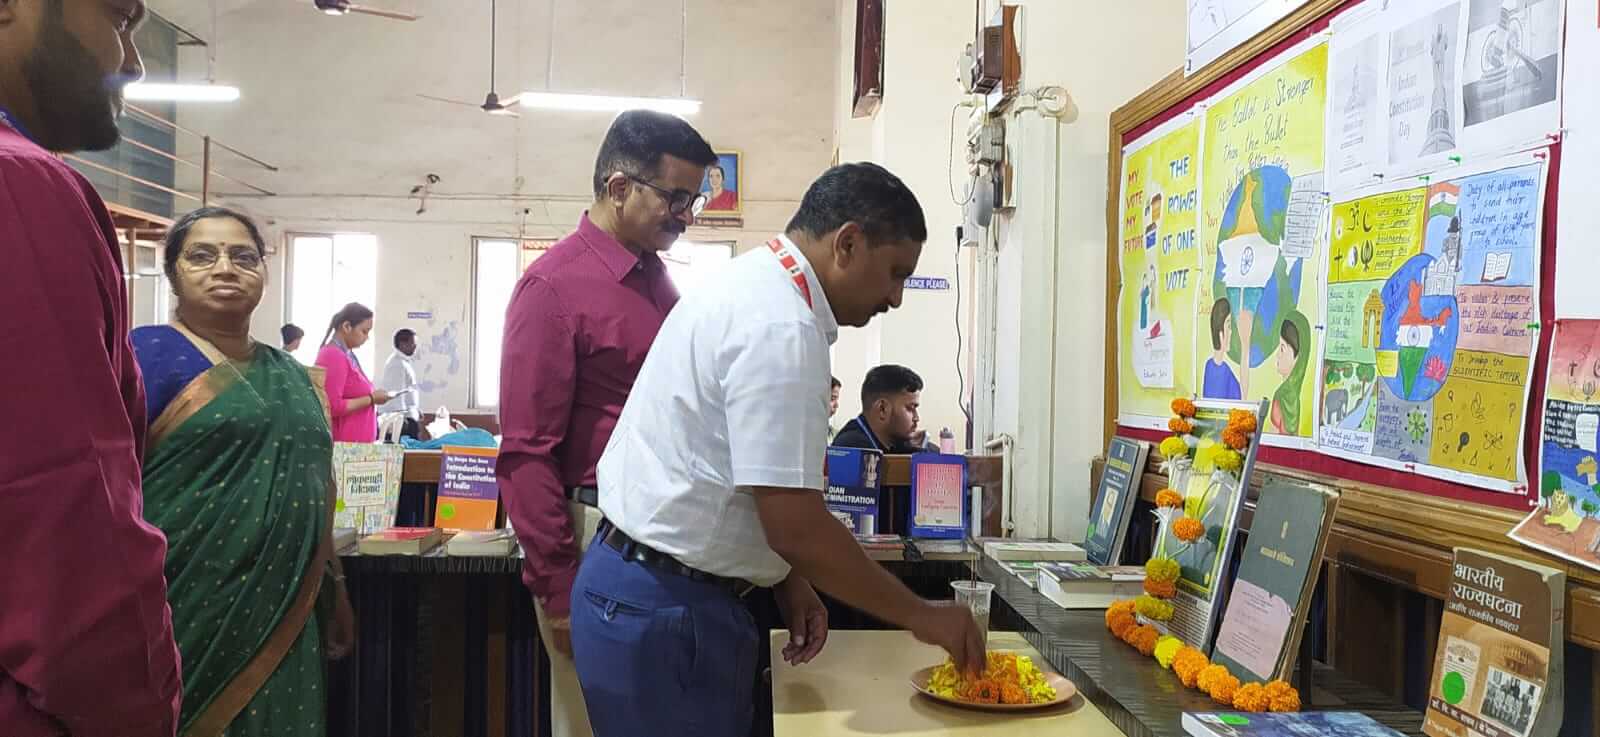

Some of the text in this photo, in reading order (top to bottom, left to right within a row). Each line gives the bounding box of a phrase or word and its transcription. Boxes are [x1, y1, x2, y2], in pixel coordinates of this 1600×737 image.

[1276, 78, 1314, 107] Stronger
[1169, 156, 1190, 177] THE
[1128, 168, 1139, 187] MY
[1126, 191, 1143, 208] VOTE
[1484, 197, 1502, 208] send
[1126, 214, 1136, 231] MY
[1513, 210, 1529, 225] age
[1162, 230, 1195, 254] OF ONE
[1166, 269, 1189, 292] VOTE
[446, 464, 495, 474] Introduction to
[443, 481, 471, 490] of India
[445, 472, 497, 484] the Constitution
[824, 494, 876, 505] MINISTRATION
[829, 487, 845, 495] DIAN
[1454, 563, 1505, 592] भारतीय
[1452, 582, 1523, 620] राज्यघटना
